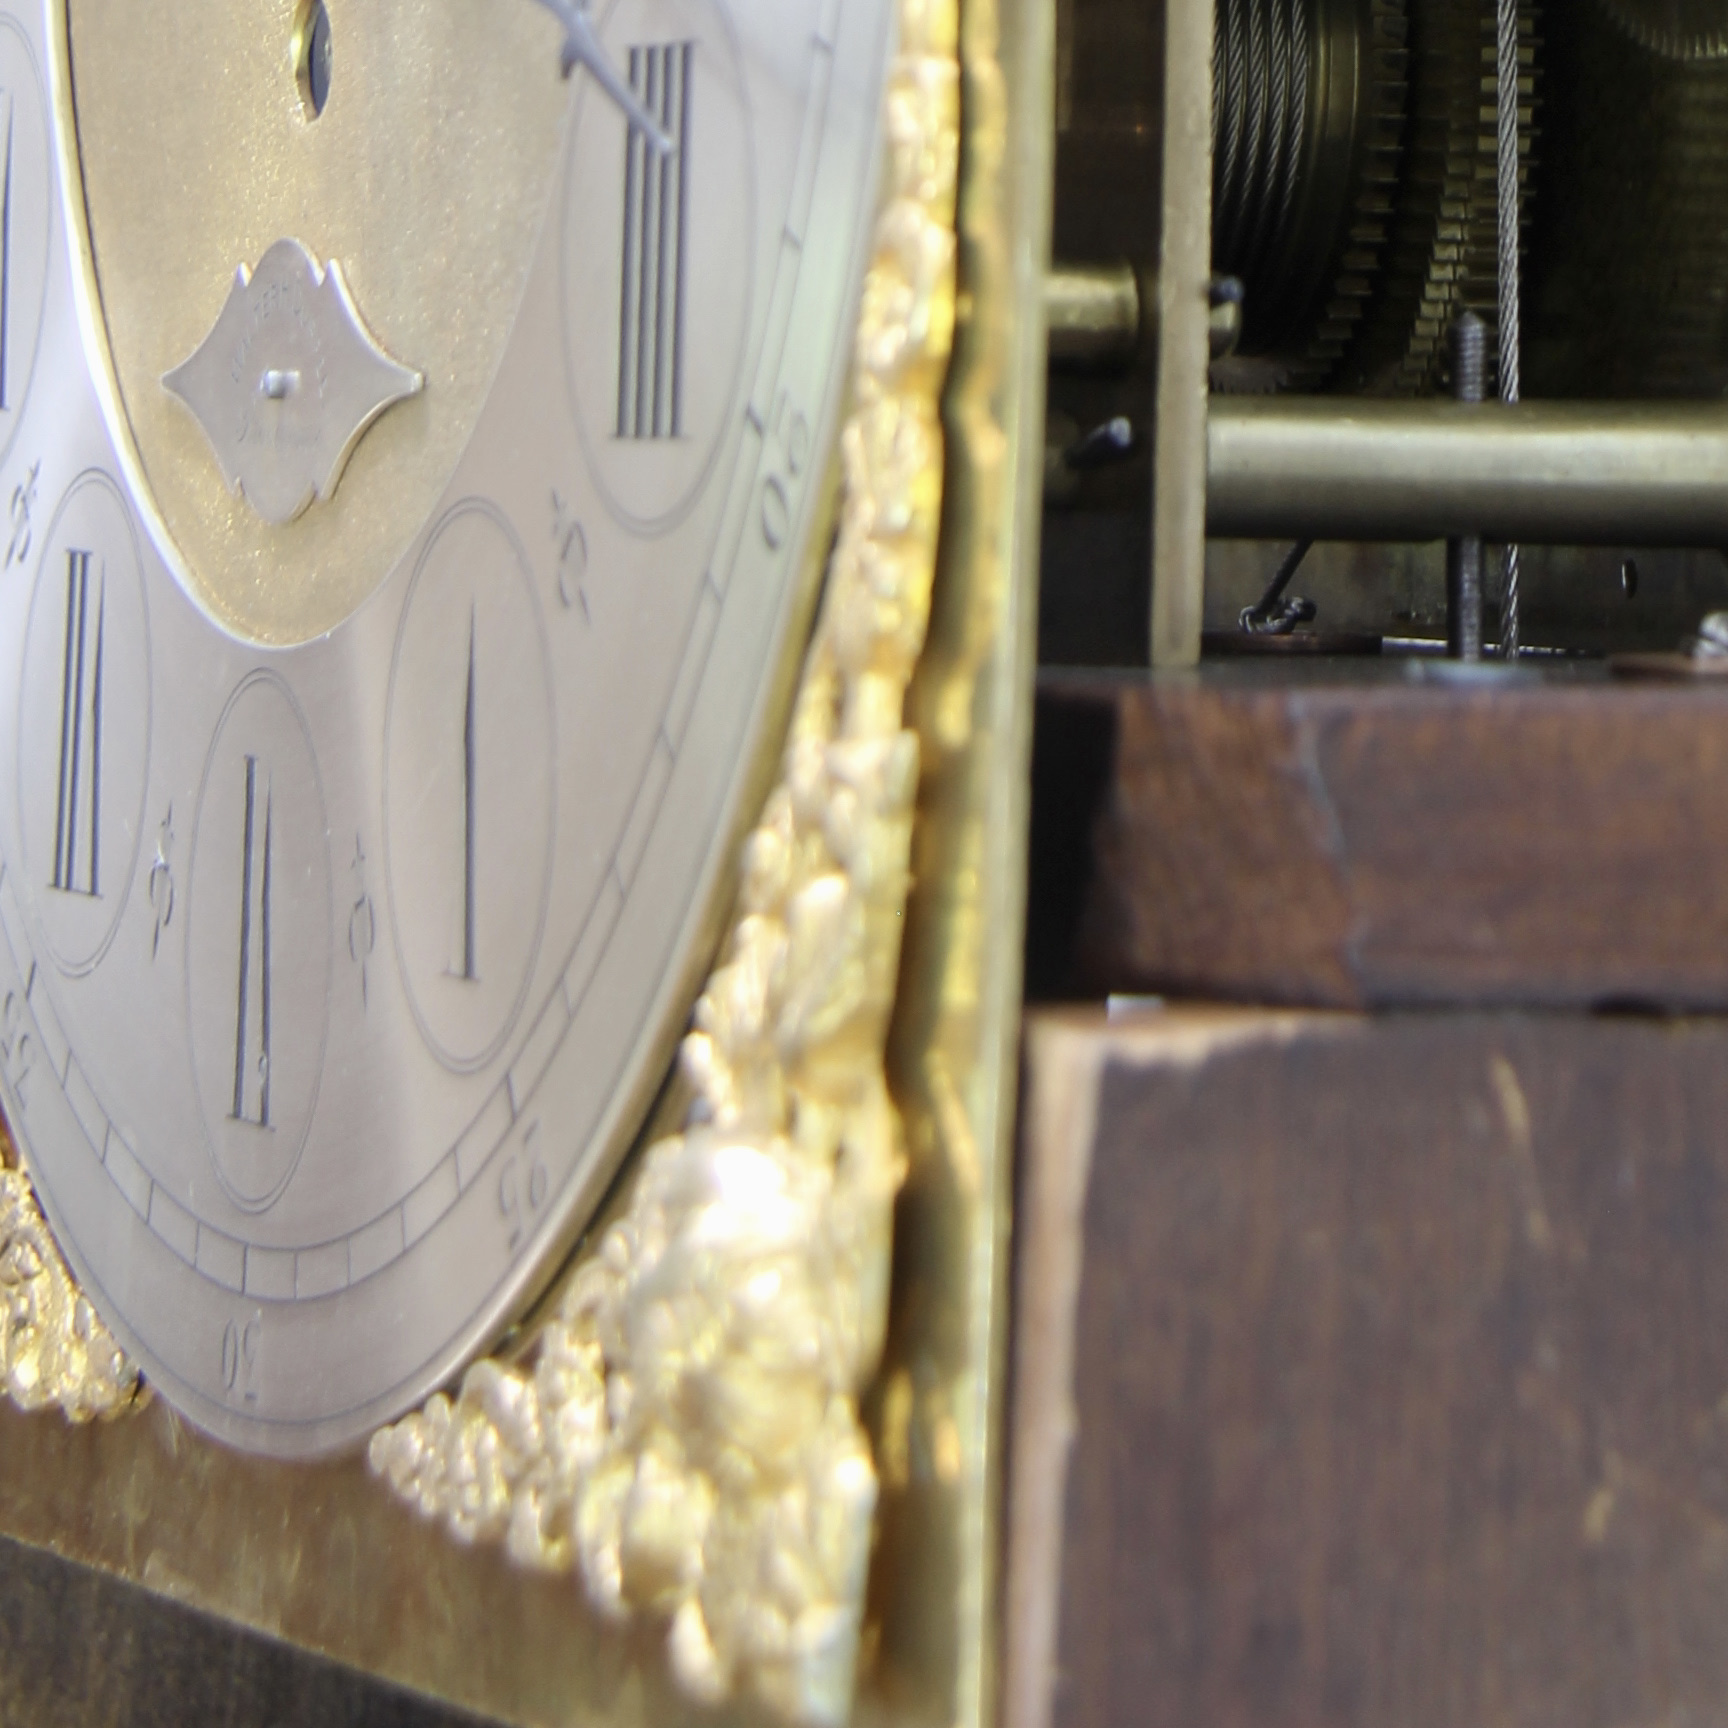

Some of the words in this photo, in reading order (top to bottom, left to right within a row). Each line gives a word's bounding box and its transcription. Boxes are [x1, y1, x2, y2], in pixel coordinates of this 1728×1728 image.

[761, 387, 808, 552] 20
[498, 1118, 547, 1250] 25
[221, 1316, 260, 1402] 30
